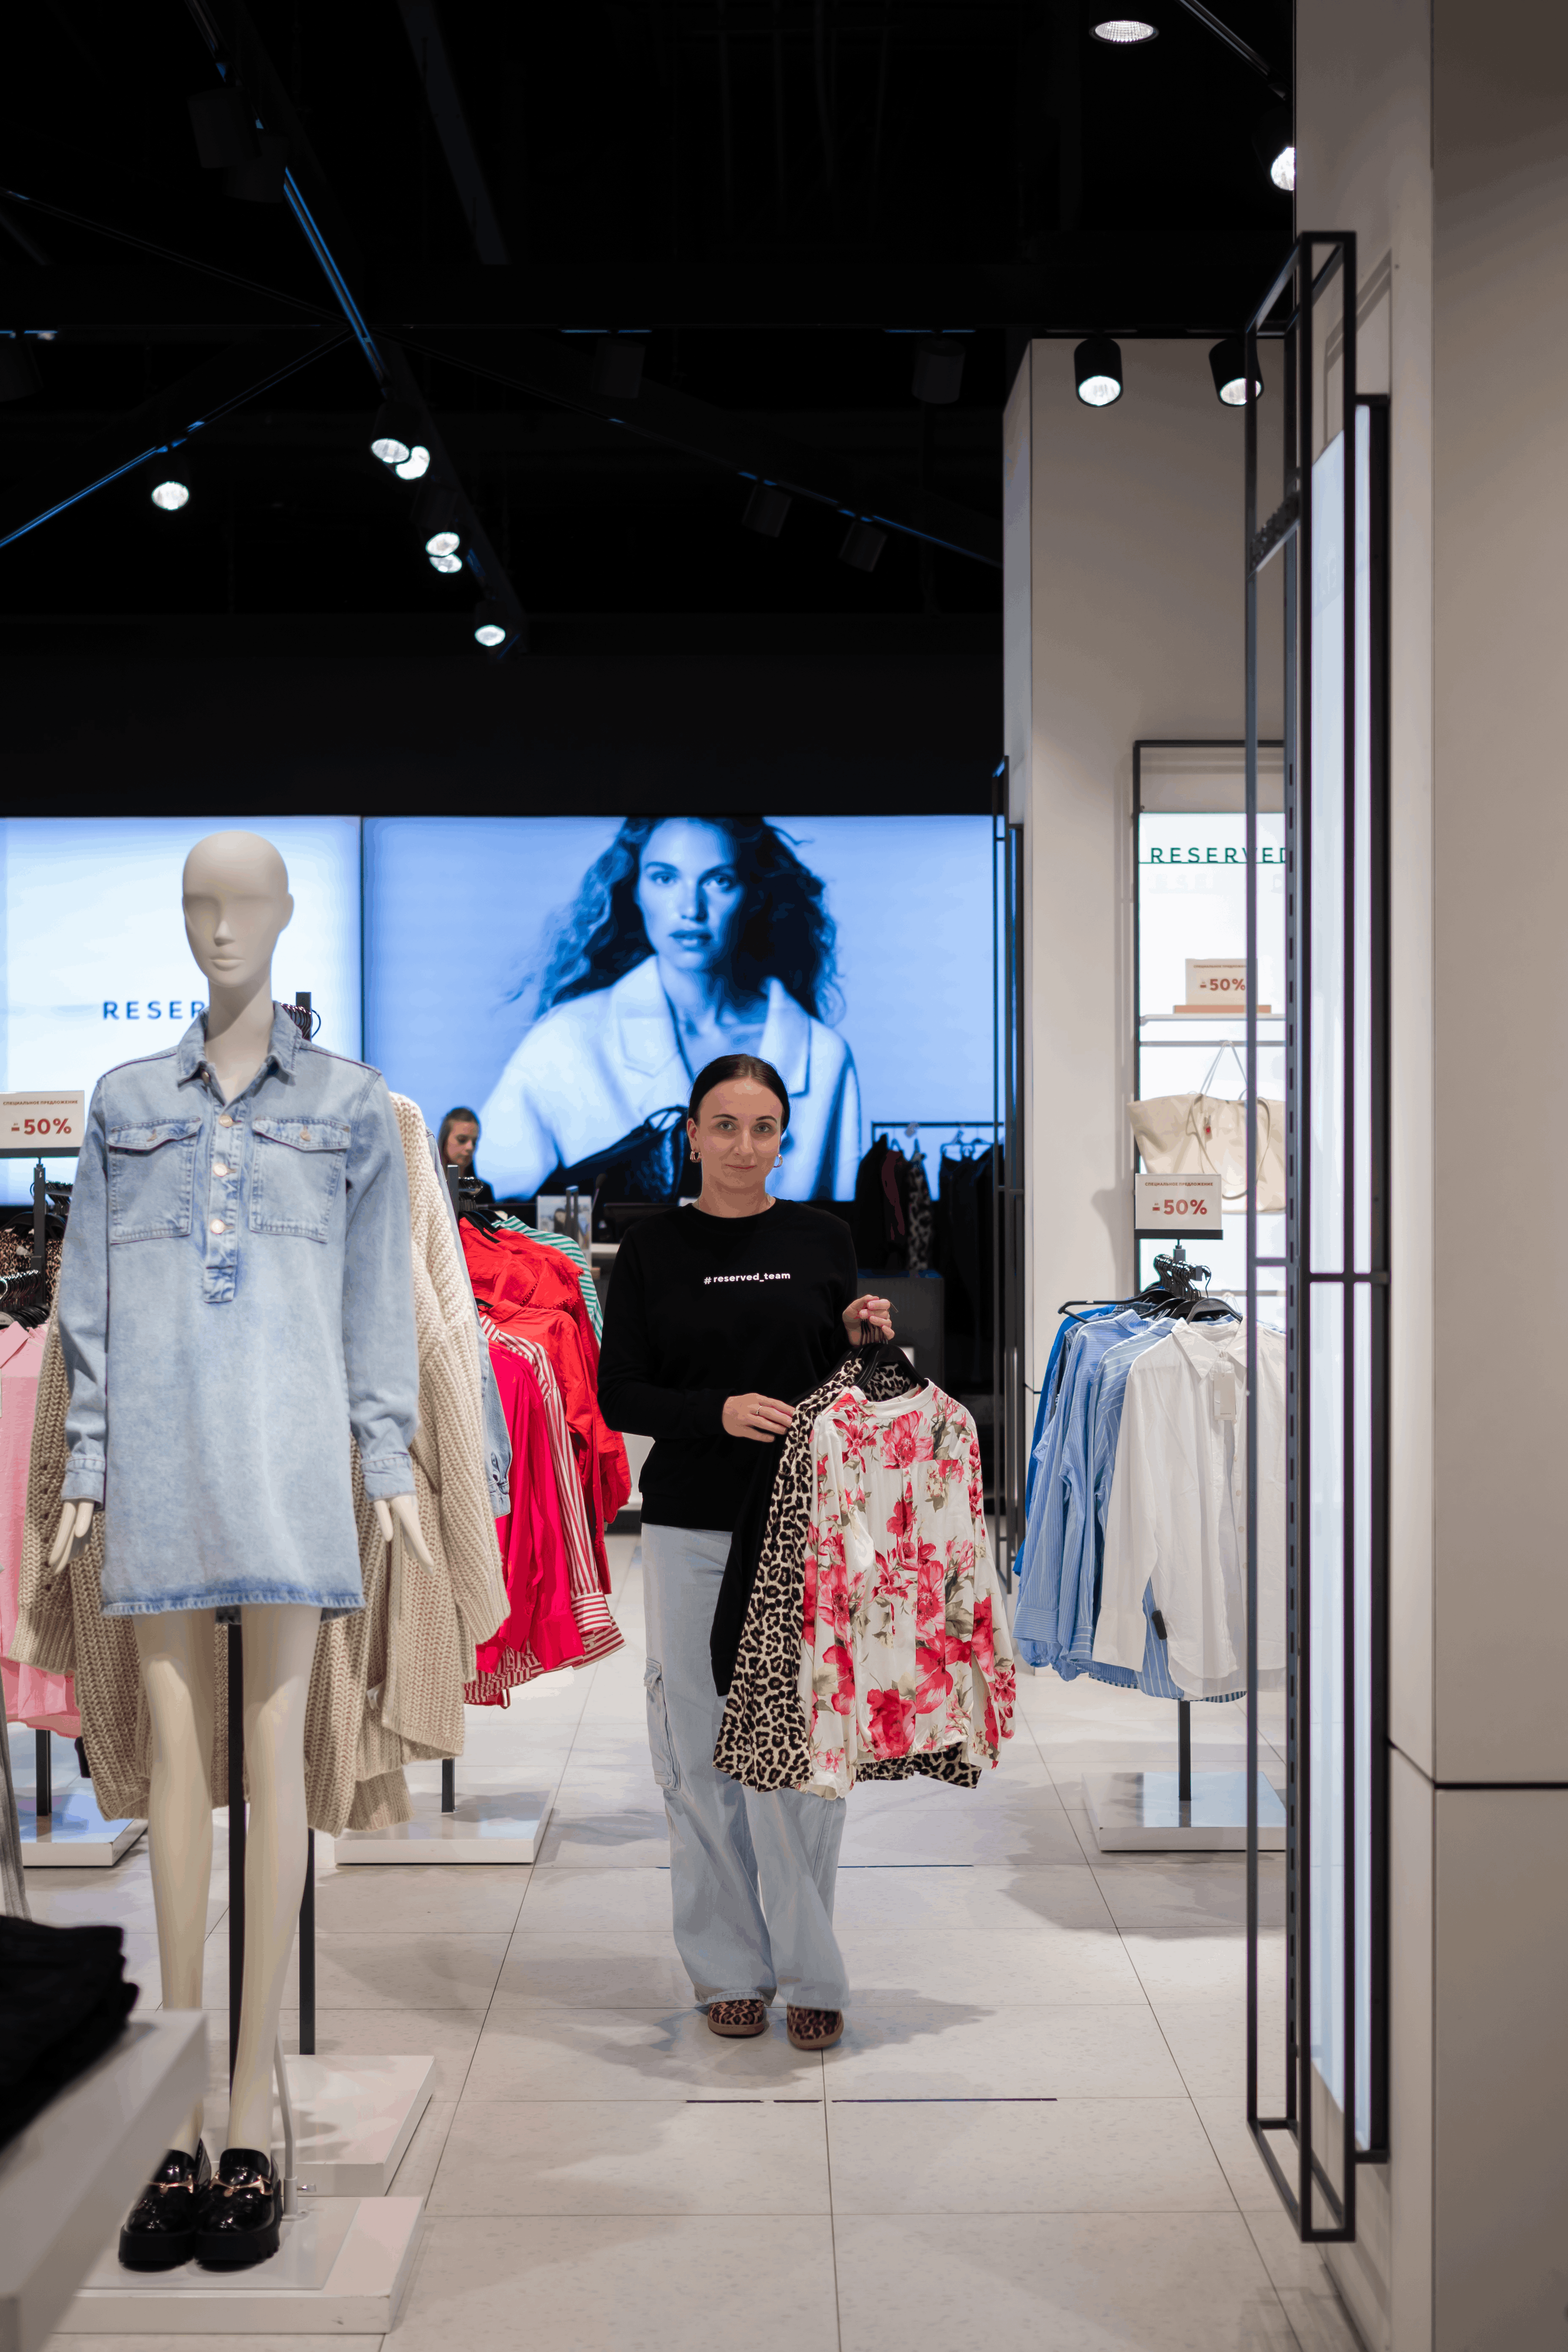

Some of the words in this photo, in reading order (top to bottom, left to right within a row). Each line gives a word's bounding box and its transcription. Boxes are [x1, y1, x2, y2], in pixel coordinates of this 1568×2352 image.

[1200, 978, 1245, 991] -50%
[103, 1000, 205, 1020] RESER
[11, 1118, 71, 1135] -50%
[1152, 1199, 1207, 1215] -50%
[704, 1273, 790, 1285] #reserved_team
